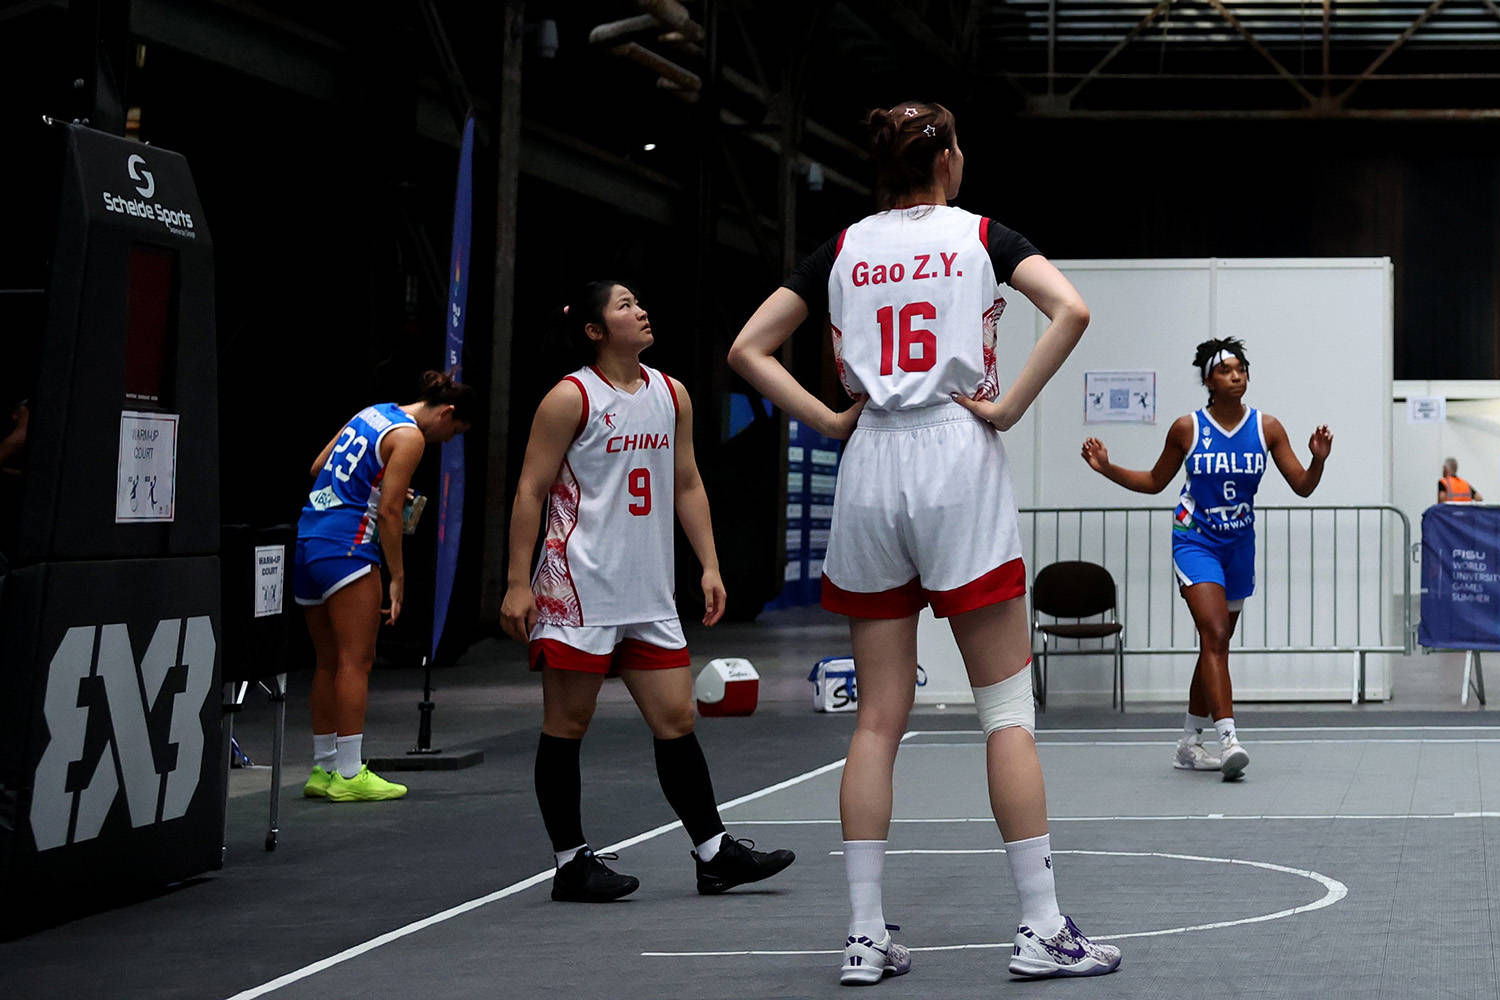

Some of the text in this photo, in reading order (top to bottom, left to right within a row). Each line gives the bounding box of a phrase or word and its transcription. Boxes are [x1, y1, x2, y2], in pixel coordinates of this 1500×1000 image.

[103, 191, 193, 229] Schelde Sports
[852, 252, 963, 287] Gao Z.Y.
[877, 301, 937, 376] 16
[323, 426, 368, 482] 23
[606, 433, 670, 453] CHINA
[1192, 452, 1265, 475] ITALIA
[628, 467, 652, 516] 9
[1222, 480, 1237, 500] 6
[1452, 561, 1487, 571] WORLD
